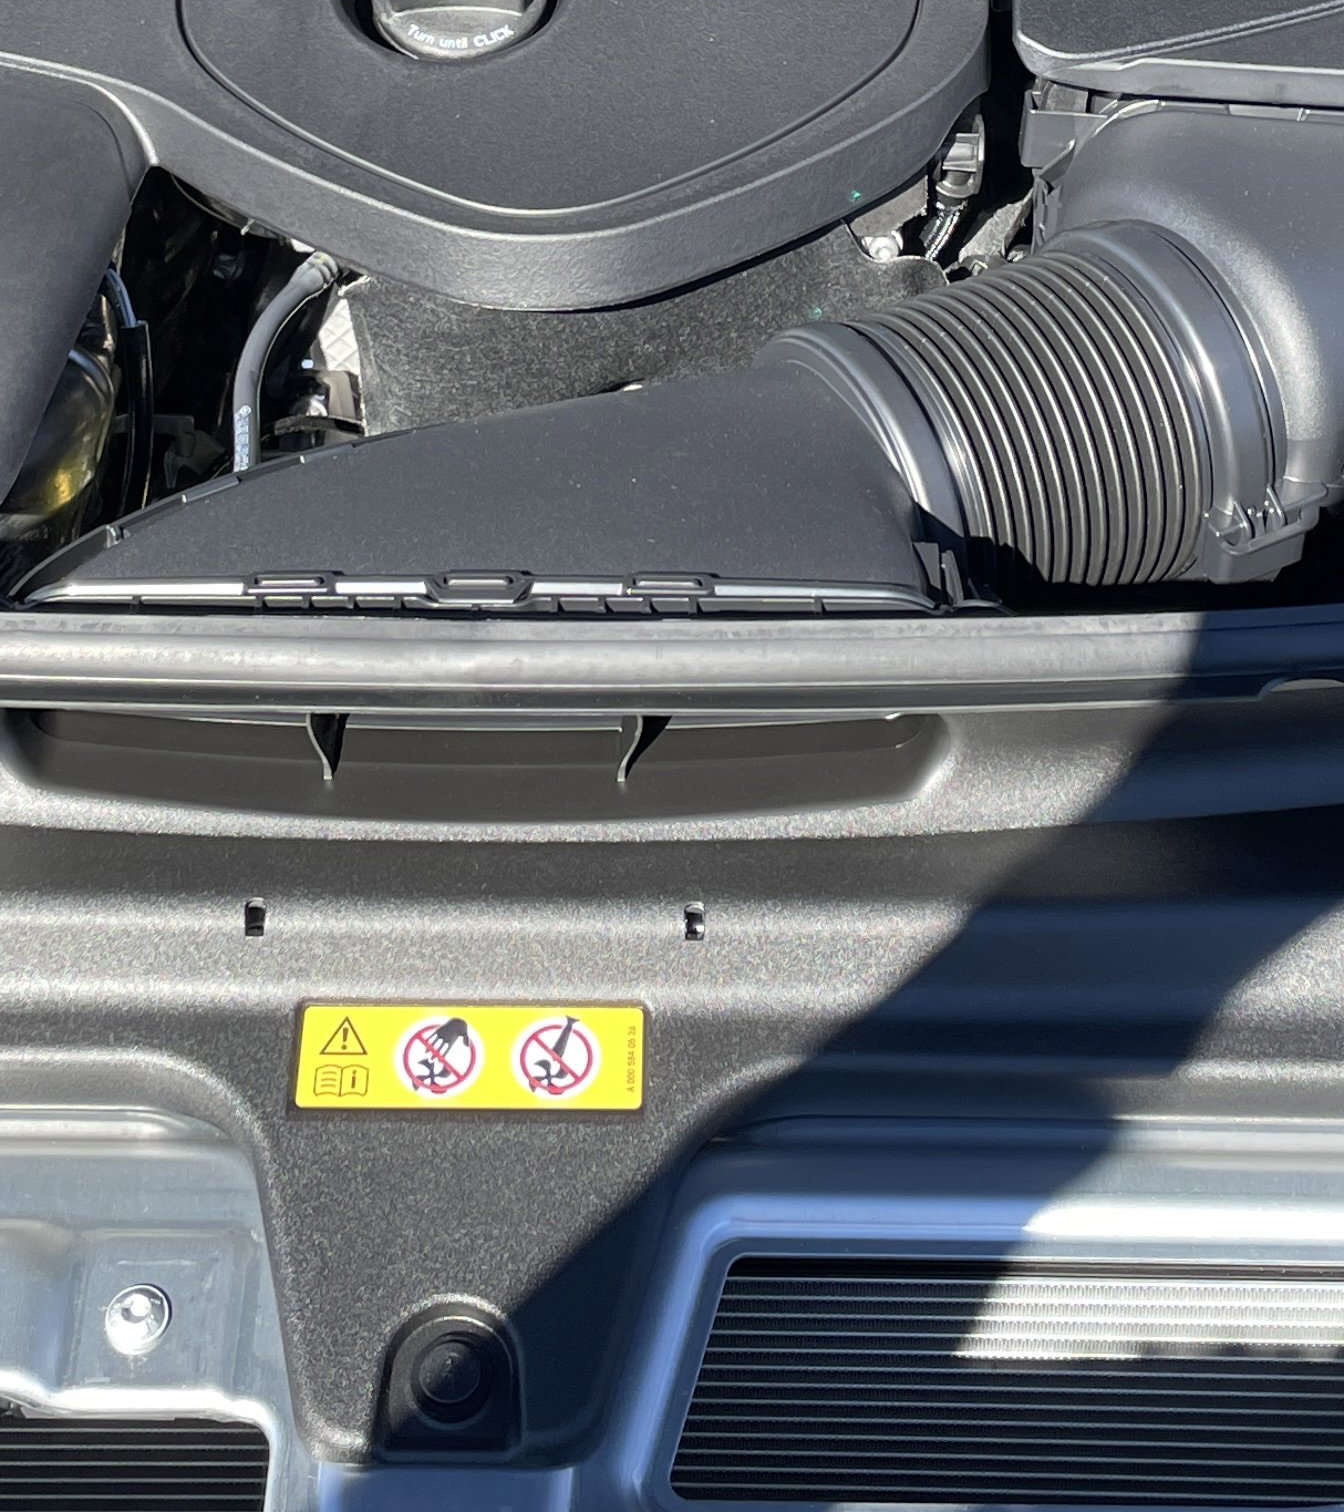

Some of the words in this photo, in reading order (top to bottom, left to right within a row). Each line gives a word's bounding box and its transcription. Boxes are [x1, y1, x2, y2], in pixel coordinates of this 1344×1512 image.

[407, 23, 435, 45] Turn
[439, 37, 468, 49] until
[473, 24, 515, 47] CLICK
